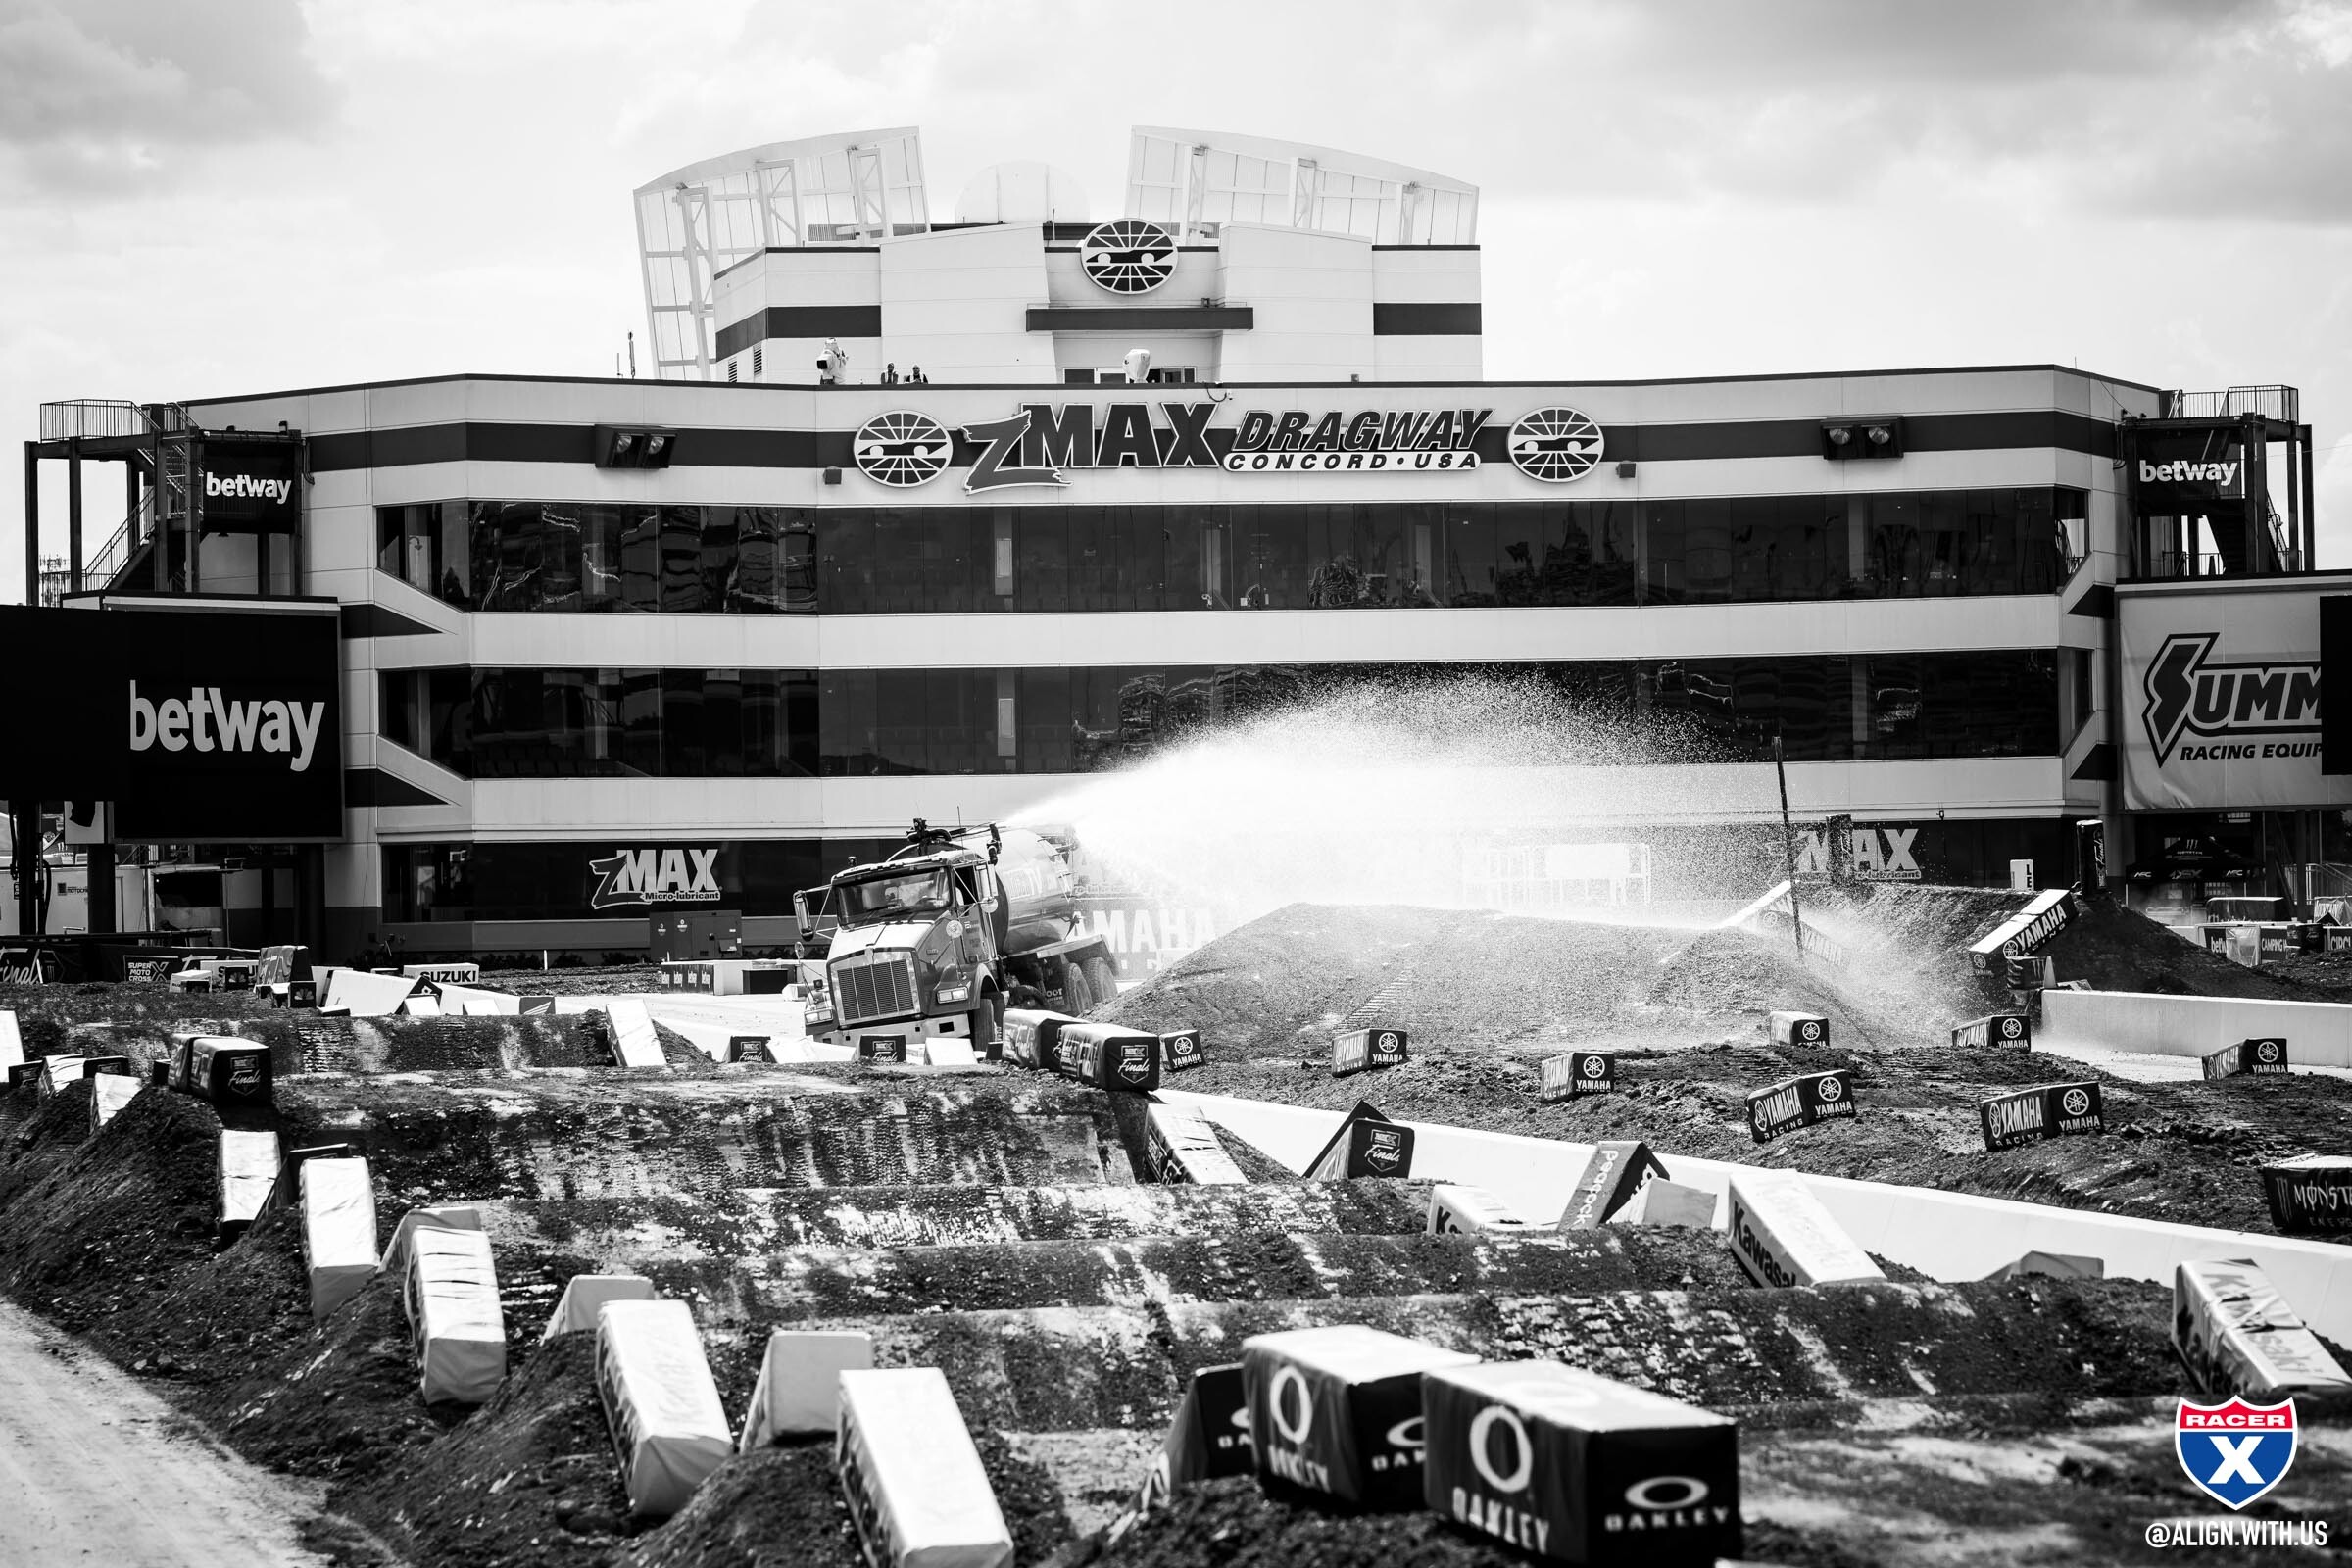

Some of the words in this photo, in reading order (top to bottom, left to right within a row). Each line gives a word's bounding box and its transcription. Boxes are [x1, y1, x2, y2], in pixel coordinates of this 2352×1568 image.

[958, 402, 1221, 495] ZMAX
[1231, 409, 1494, 452] DRAGWAY
[1228, 453, 1388, 470] CONCORD
[1414, 452, 1477, 469] USA
[2139, 459, 2238, 486] betway
[206, 471, 292, 505] betway
[2146, 637, 2322, 760] SUMM
[129, 679, 325, 772] betway
[2180, 744, 2256, 760] RACING
[2262, 743, 2323, 759] EQUIP
[643, 891, 720, 901] Micro-lubricant
[1063, 908, 1219, 954] AMAHA
[2016, 903, 2067, 951] YAMAHA
[419, 970, 477, 983] SUZUKI
[1998, 1039, 2029, 1049] YAMAHA
[1117, 1057, 1150, 1074] Finals
[1172, 1053, 1202, 1068] YAMAHA
[1372, 1054, 1403, 1063] YAMAHA
[2252, 1064, 2287, 1074] YAMAHA
[1576, 1079, 1611, 1090] YAMAHA
[1763, 1085, 1803, 1126] YAMAHA
[1814, 1101, 1853, 1115] YAMAHA
[2000, 1096, 2044, 1134] YAMAHA
[2059, 1115, 2101, 1132] YAMAHA
[1764, 1118, 1804, 1139] RACING
[1364, 1144, 1401, 1162] Finals
[1452, 1486, 1549, 1554] OAKLEY
[1604, 1506, 1730, 1532] OAKLEY
